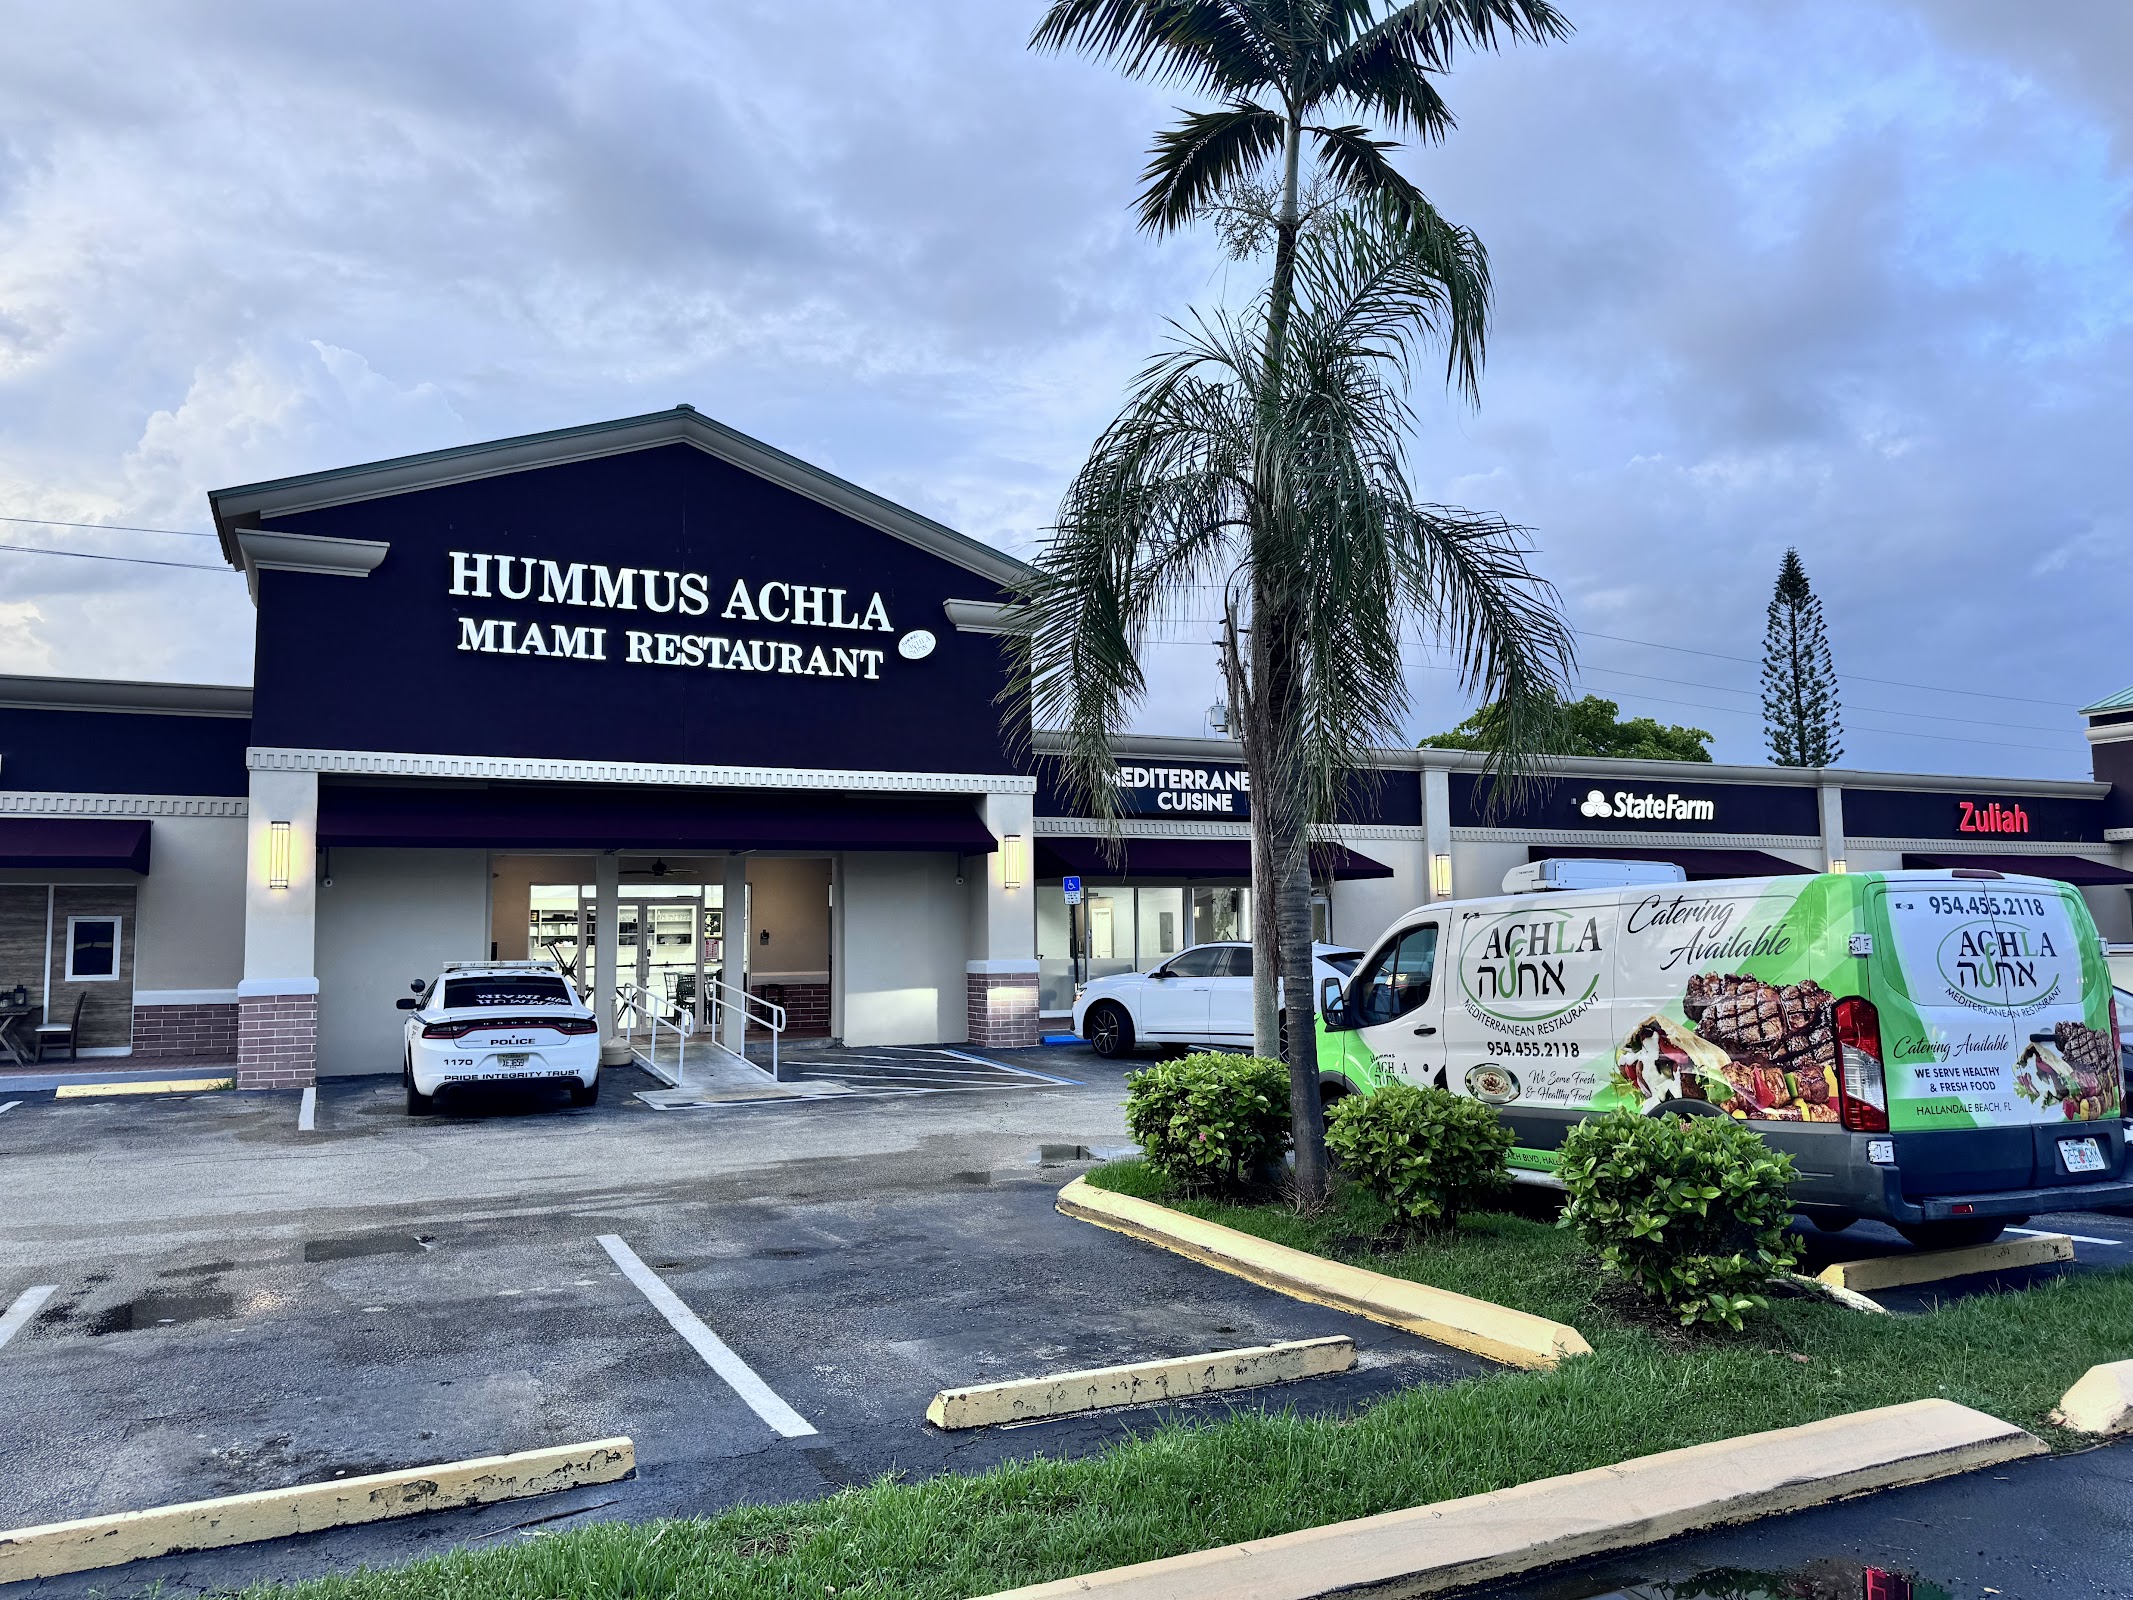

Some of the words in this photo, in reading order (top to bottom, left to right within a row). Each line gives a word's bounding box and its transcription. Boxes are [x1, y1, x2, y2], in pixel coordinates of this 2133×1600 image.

[449, 551, 709, 616] HUMMUS
[721, 578, 894, 632] ACHLA
[457, 617, 607, 660] MIAMI
[625, 630, 884, 680] RESTAURANT
[1103, 766, 1250, 792] MEDITERRANE
[1157, 791, 1233, 812] CUISINE
[1959, 801, 2029, 833] Zuliah
[1627, 894, 1736, 939] Catering
[1928, 896, 2045, 917] 954.455.2118
[1481, 916, 1602, 959] ACHLA
[1660, 923, 1793, 971] Available
[1958, 930, 2058, 957] ACHLA
[1945, 987, 2021, 1019] MEDITERRANEAN
[2021, 985, 2062, 1017] RESTAURANT
[1463, 998, 1535, 1037] MEDITERRANEAN
[1538, 991, 1599, 1036] RESTAURANT
[490, 1038, 536, 1046] POLICE
[1487, 1041, 1580, 1058] 954.455.2118
[1893, 1036, 1951, 1062] Catering
[1953, 1033, 2010, 1057] Available
[482, 1071, 542, 1080] INTEGRITY
[546, 1069, 580, 1077] TRUST
[1375, 1061, 1408, 1074] ACHA
[1528, 1069, 1545, 1084] We
[1547, 1070, 1570, 1085] Serve
[1571, 1071, 1596, 1086] Fresh
[1915, 1068, 1931, 1078] WE
[1933, 1067, 1961, 1078] SERVE
[1962, 1066, 2000, 1077] HEALTHY
[1537, 1086, 1570, 1106] Healthy
[1570, 1087, 1593, 1103] Food
[1930, 1083, 1938, 1093] &
[1940, 1081, 1968, 1092] FRESH
[1969, 1081, 1996, 1091] FOOD
[1916, 1103, 1972, 1115] HALLANDALE
[1974, 1102, 2002, 1113] BEACH,
[2004, 1101, 2012, 1111] FL
[1503, 1152, 1521, 1161] EACH
